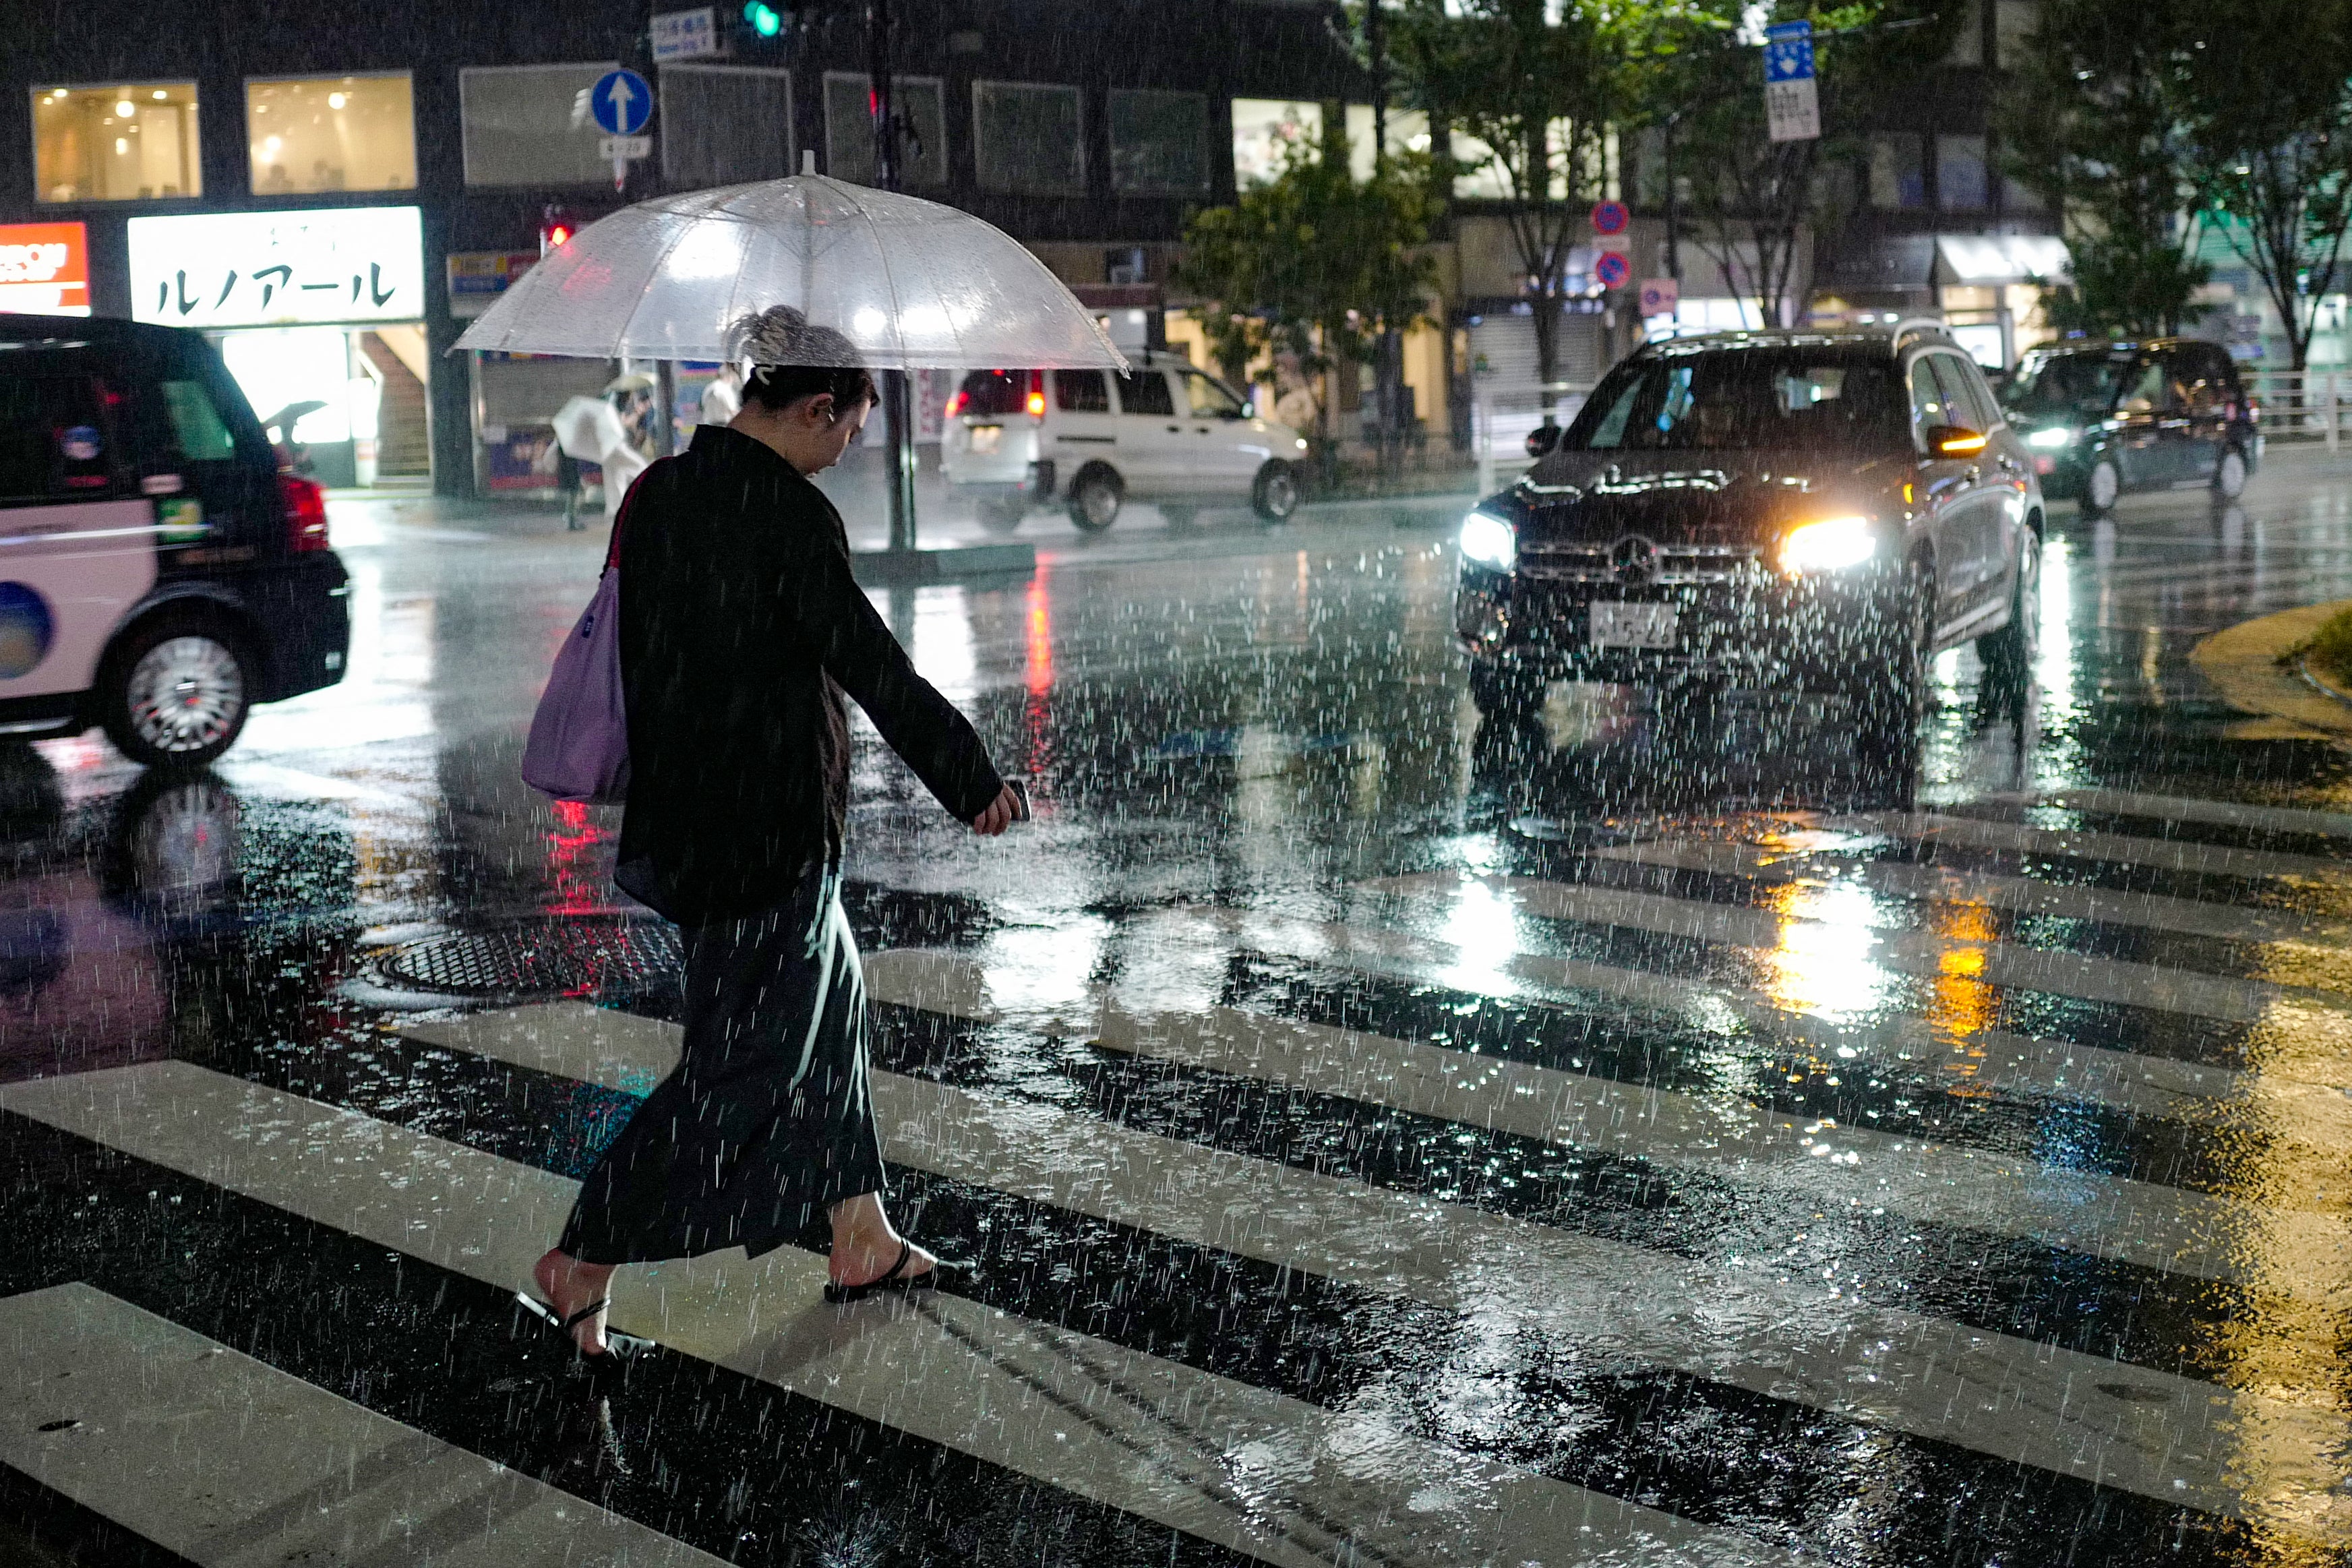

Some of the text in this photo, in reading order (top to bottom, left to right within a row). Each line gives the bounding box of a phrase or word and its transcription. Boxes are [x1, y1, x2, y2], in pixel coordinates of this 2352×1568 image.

[157, 262, 396, 316] ルノアール
